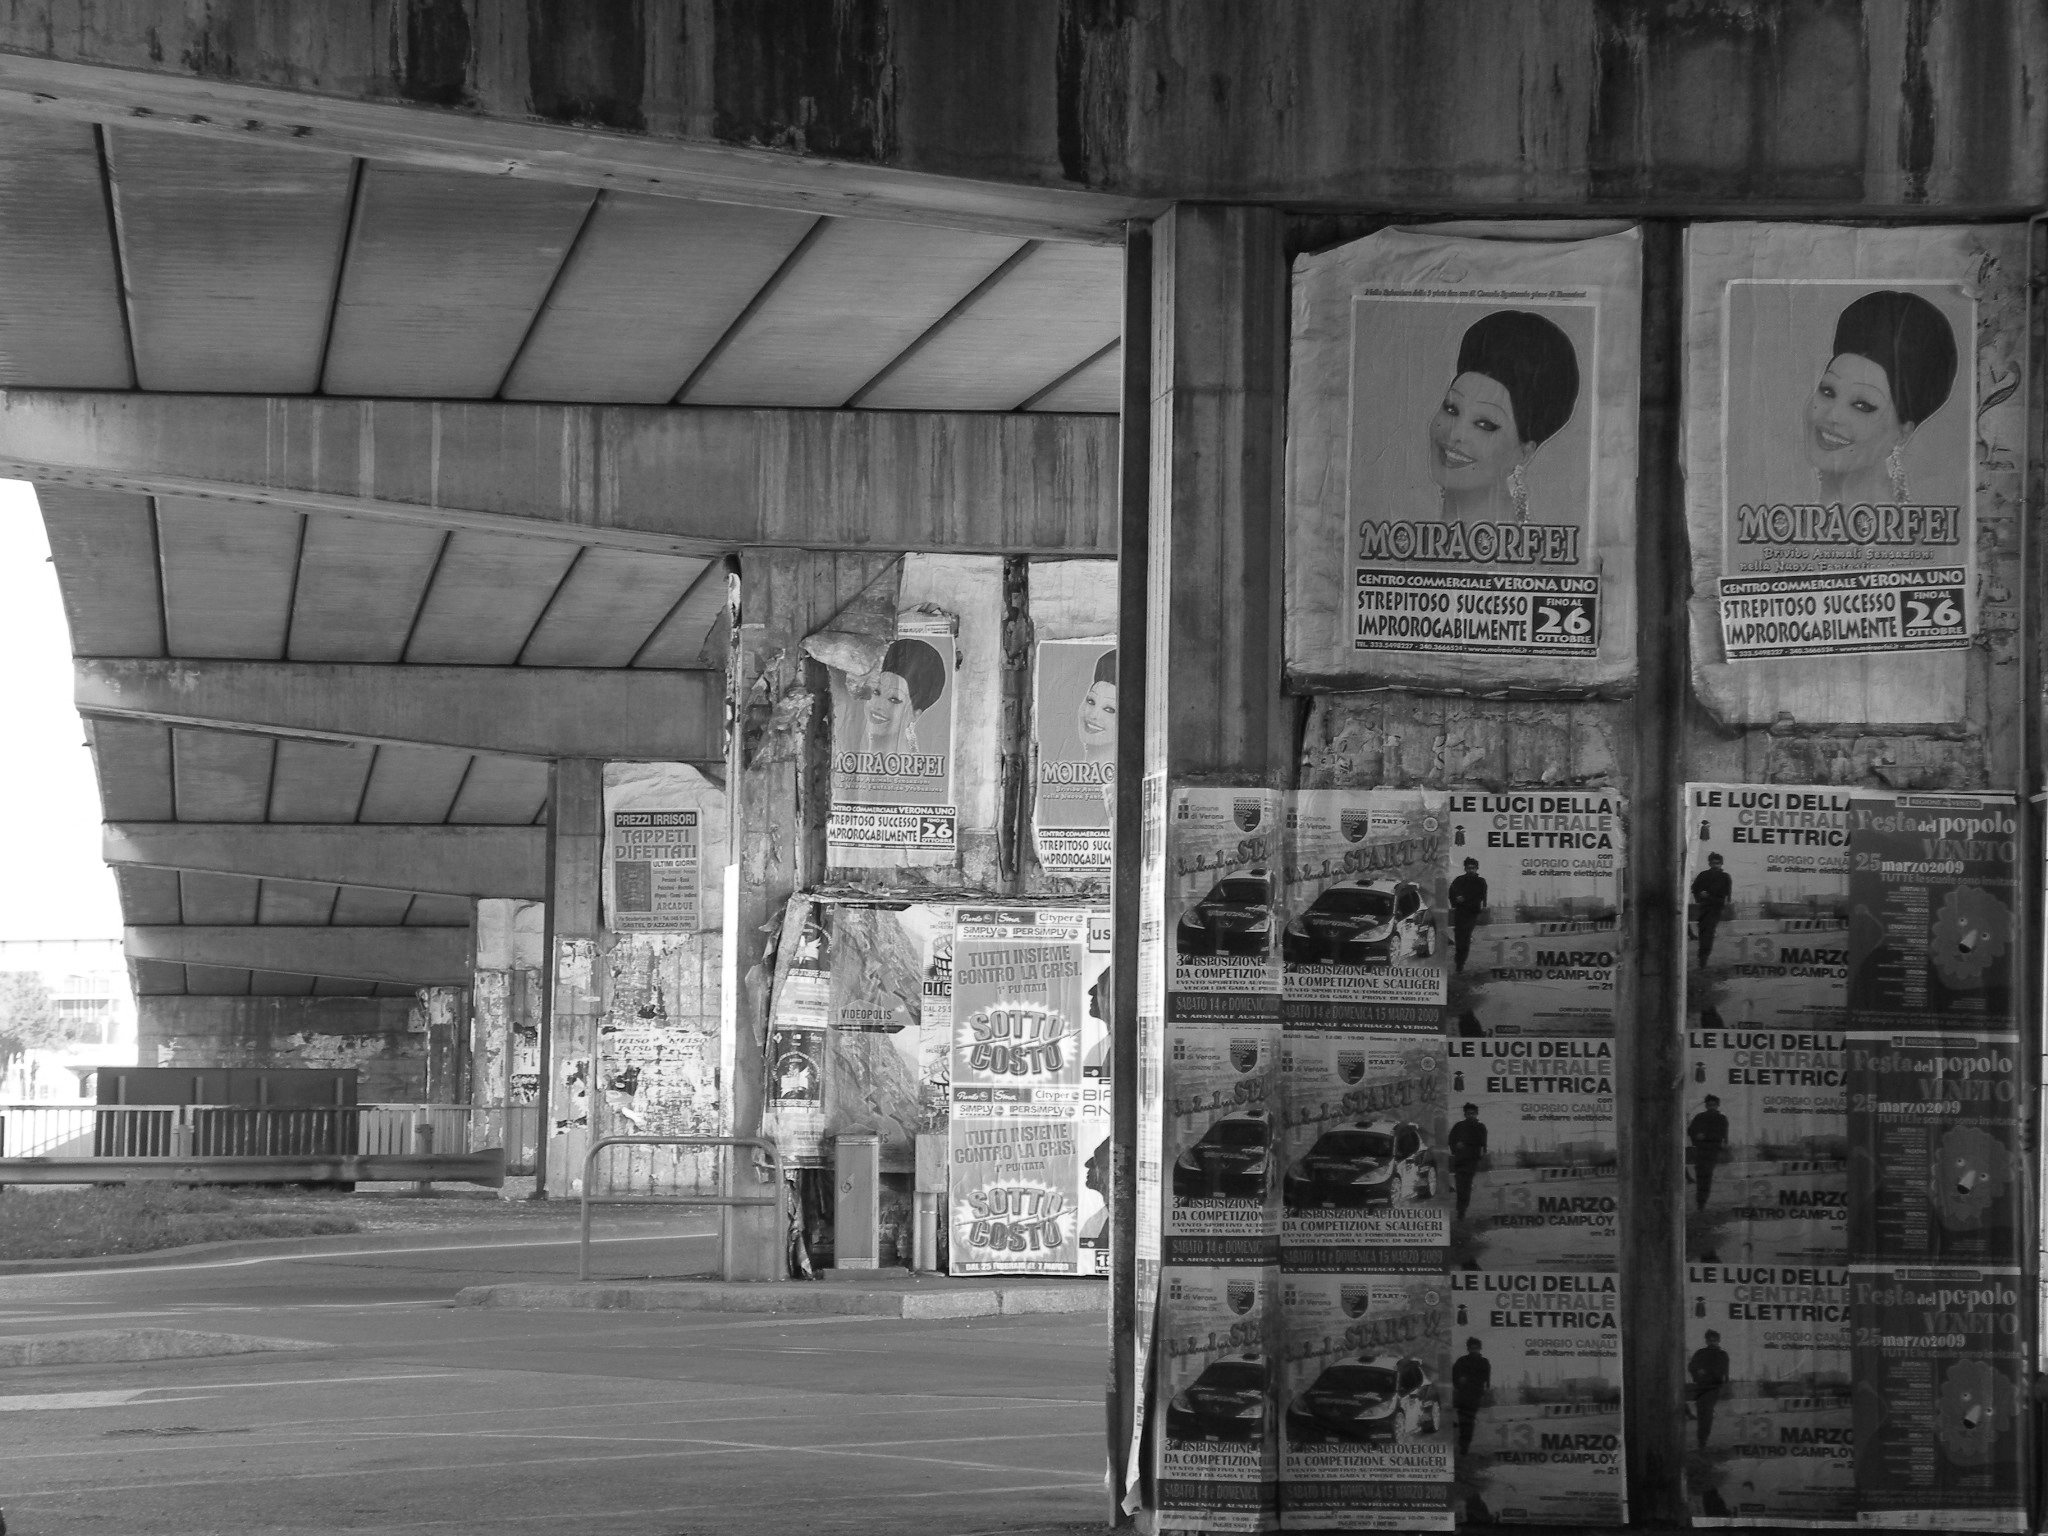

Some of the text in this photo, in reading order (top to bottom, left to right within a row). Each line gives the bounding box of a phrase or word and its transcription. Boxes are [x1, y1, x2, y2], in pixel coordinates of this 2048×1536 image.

[1359, 574, 1596, 592] CENTRO COMMERCIALE VERONA UNO
[1723, 571, 1963, 594] CENTRO COMMERCIALE VERONA UNO
[1547, 598, 1569, 607] FINO
[1914, 591, 1935, 599] FINO
[1358, 591, 1528, 615] STREPITOSO SUCCESSO
[1724, 592, 1895, 619] STREPITOSO SUCCESSO
[1536, 607, 1592, 634] 26
[1906, 599, 1961, 627] 26
[1358, 614, 1527, 642] IMPROROGABILMENTE
[1726, 617, 1897, 645] IMPROROGABILMENTE
[1906, 627, 1963, 637] OTTOBRE
[1536, 634, 1592, 643] OTTOBRE
[1450, 796, 1612, 814] LE LUCI DELLA
[1697, 791, 1779, 809] LE LUCI
[617, 814, 695, 825] PREZZI IRRISORI
[879, 817, 917, 828] SUCCESSO
[1493, 814, 1612, 831] CENTRALE
[1856, 809, 2017, 840] Festa del popolo
[622, 830, 689, 844] TAPPETI
[922, 823, 952, 838] 26
[1040, 840, 1089, 850] STREPITOSO
[1488, 832, 1612, 849] ELETTRICA
[615, 845, 696, 859] DIFETTATI
[1922, 838, 2017, 862] VENETO
[1522, 859, 1612, 868] GIORGIO CANALI
[1767, 855, 1814, 865] GIORGIO
[1855, 852, 1881, 871] 25
[1880, 873, 1914, 883] TUTTE
[657, 902, 693, 910] ARCADUE
[1039, 914, 1073, 923] Cityper
[968, 946, 1070, 967] TUTTI INSIEME
[1491, 942, 1614, 967] 13 MARZO
[1734, 938, 1775, 962] 13
[958, 965, 1037, 985] CONTRO LA
[1176, 968, 1190, 978] DA
[1372, 966, 1440, 978] AUTOVEICOLI
[1492, 968, 1611, 980] TEATRO CAMPLOY
[1734, 965, 1786, 976] TEATRO
[1009, 983, 1047, 994] PUNTATA
[1299, 977, 1440, 989] COMPETIZIONE SCALIGERI
[1176, 997, 1207, 1010] SABATO
[841, 1009, 892, 1020] VIDEOPOLIS
[1333, 1005, 1373, 1020] DOMENICA
[969, 1010, 1064, 1041] SOTTO
[1690, 1032, 1775, 1050] LE LUCI
[1448, 1041, 1611, 1058] LE LUCI DELLA
[969, 1043, 1064, 1076] COSTO
[1853, 1049, 2013, 1080] Festa del popolo
[1492, 1059, 1611, 1076] CENTRALE
[1487, 1077, 1612, 1093] ELETTRICA
[1035, 1091, 1069, 1100] Cityper
[1763, 1096, 1811, 1105] GIORGIO
[1852, 1094, 1878, 1112] 25
[1521, 1104, 1612, 1113] GIORGIO CANALI
[965, 1128, 1007, 1146] TUTTI
[955, 1142, 1034, 1164] CONTRO LA
[1006, 1162, 1045, 1172] PUNTATA
[968, 1187, 1063, 1219] SOTTO
[1492, 1188, 1616, 1214] 13 MARZO
[1172, 1211, 1186, 1221] DA
[1373, 1208, 1442, 1219] AUTOVEICOLI
[1492, 1215, 1614, 1226] TEATRO CAMPLOY
[1733, 1207, 1785, 1219] TEATRO
[1282, 1221, 1442, 1231] DA COMPETIZIONE SCALIGERI
[968, 1221, 1062, 1252] COSTO
[966, 1263, 979, 1271] DAL
[1452, 1275, 1616, 1292] LE LUCI DELLA
[1690, 1267, 1775, 1285] LE LUCI
[1495, 1293, 1615, 1310] CENTRALE
[1856, 1283, 1917, 1307] Festa
[1490, 1311, 1616, 1328] ELETTRICA
[1923, 1312, 2019, 1335] VENETO
[1525, 1338, 1617, 1348] GIORGIO CANALI
[1764, 1332, 1812, 1341] GIORGIO
[1856, 1328, 1881, 1346] 25
[1734, 1417, 1773, 1441] 13
[1496, 1424, 1618, 1450] 13 MARZO
[1377, 1444, 1446, 1454] AUTOVEICOLI
[1733, 1445, 1786, 1456] TEATRO
[1164, 1454, 1179, 1464] DA
[1286, 1456, 1447, 1467] DA COMPETIZIONE SCALIGERI
[1495, 1452, 1618, 1464] TEATRO CAMPLOY
